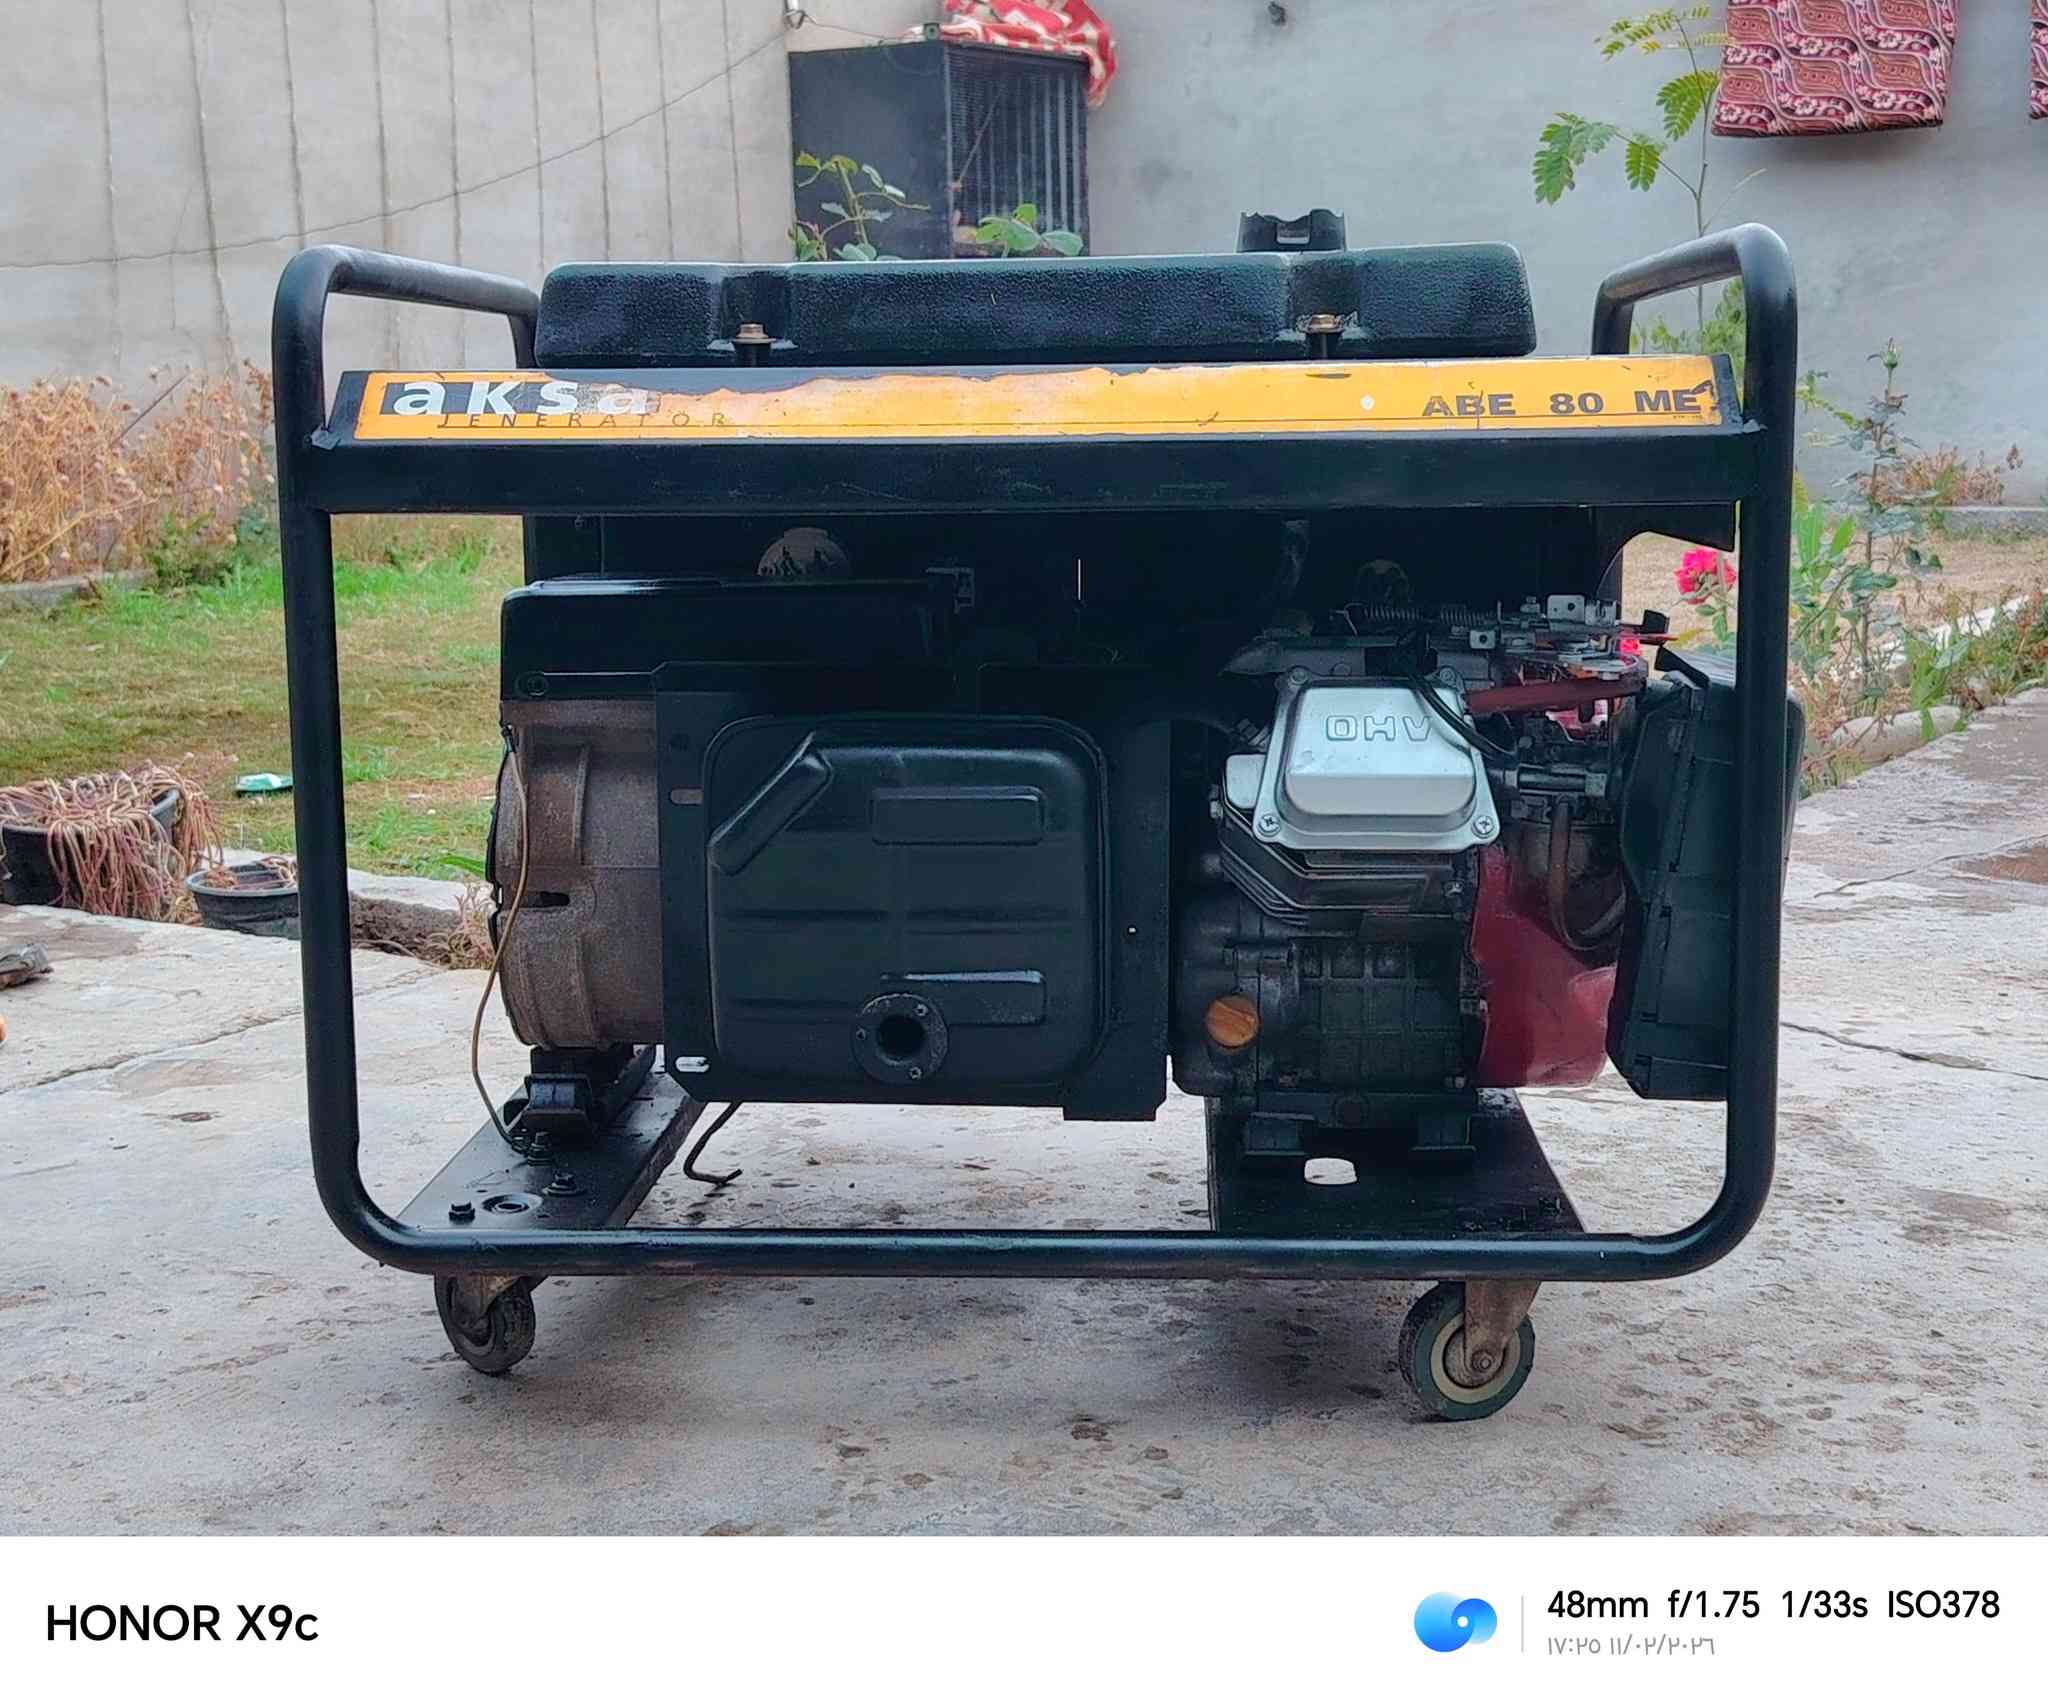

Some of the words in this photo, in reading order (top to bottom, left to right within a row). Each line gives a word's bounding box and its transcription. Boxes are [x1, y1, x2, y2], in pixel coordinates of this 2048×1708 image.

[1422, 393, 1516, 417] ABE
[1549, 392, 1604, 415] 80
[1325, 715, 1433, 742] OHV
